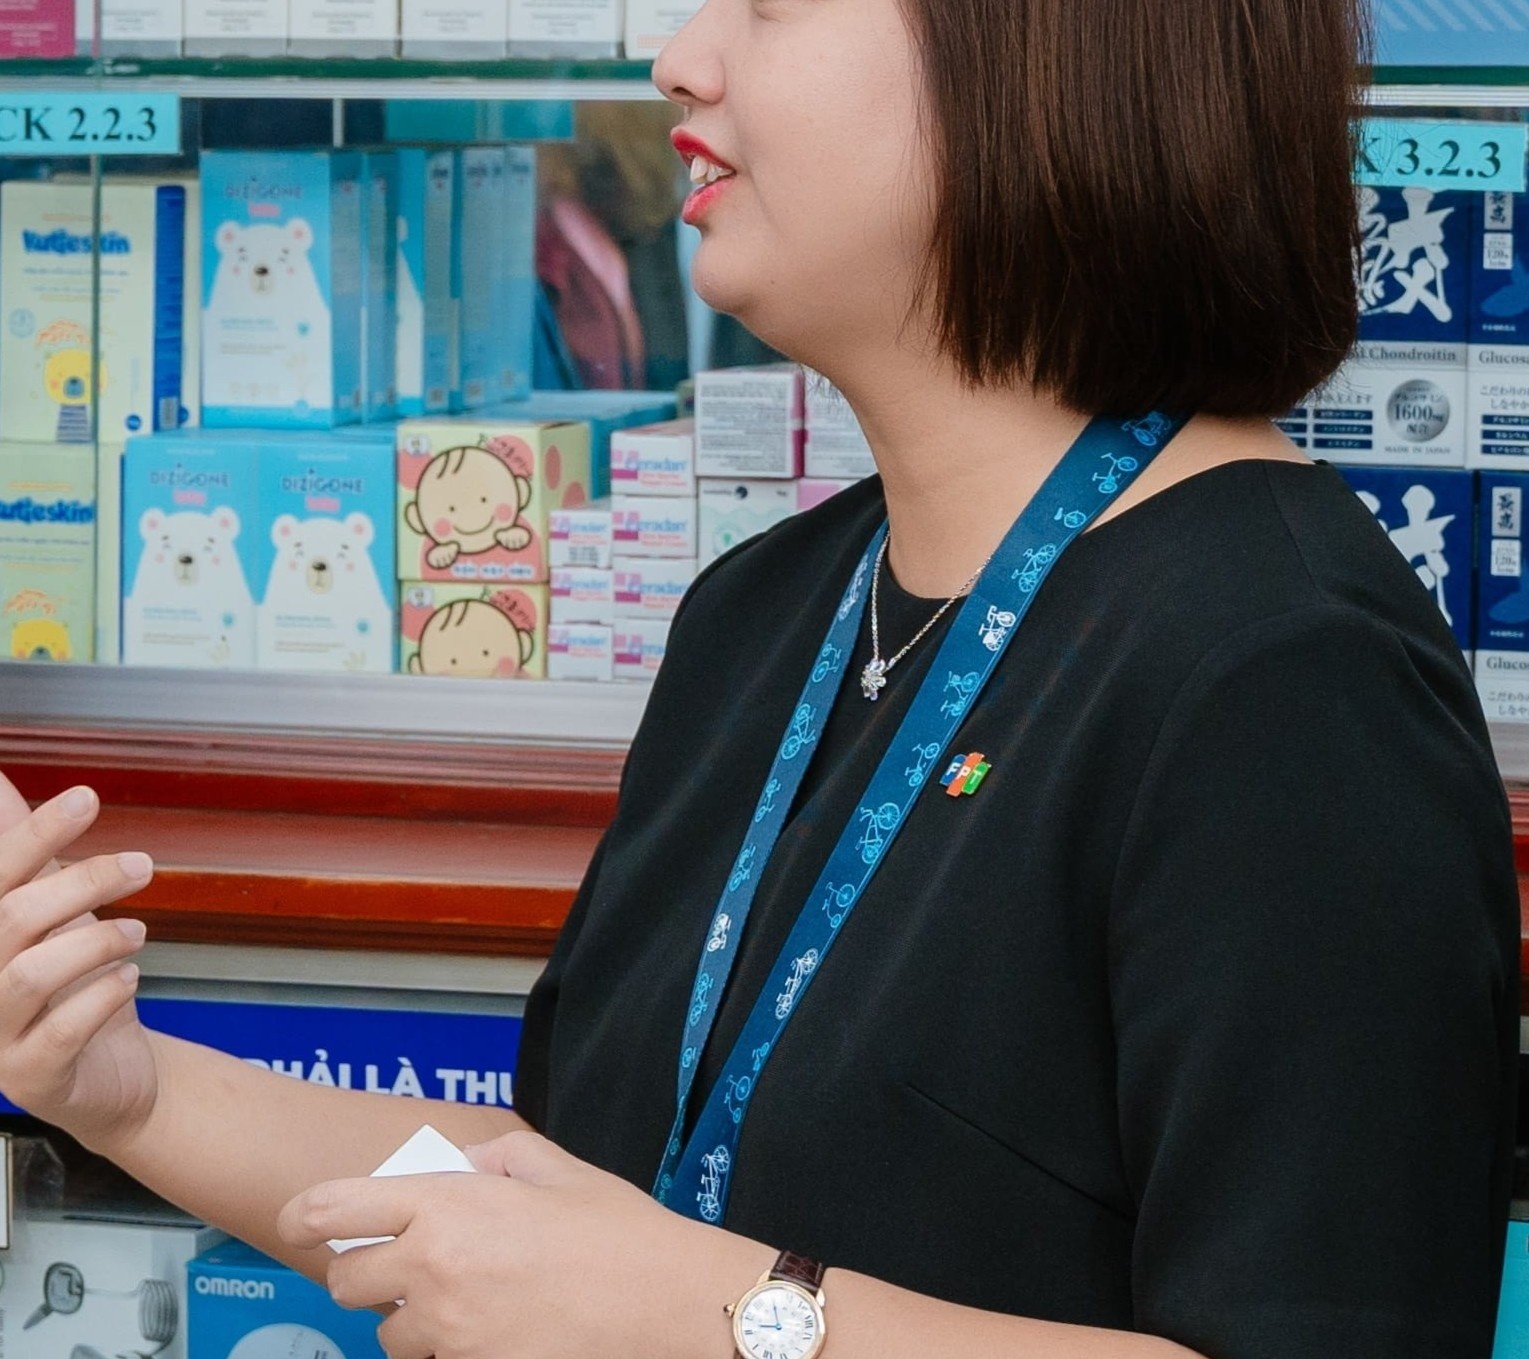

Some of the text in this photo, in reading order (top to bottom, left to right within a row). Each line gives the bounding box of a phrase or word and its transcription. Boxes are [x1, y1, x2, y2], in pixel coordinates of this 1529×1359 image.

[69, 106, 157, 142] 2.2.3
[1395, 137, 1502, 179] 3.2.3
[436, 1067, 513, 1108] THU
[194, 1274, 275, 1300] OMRON
